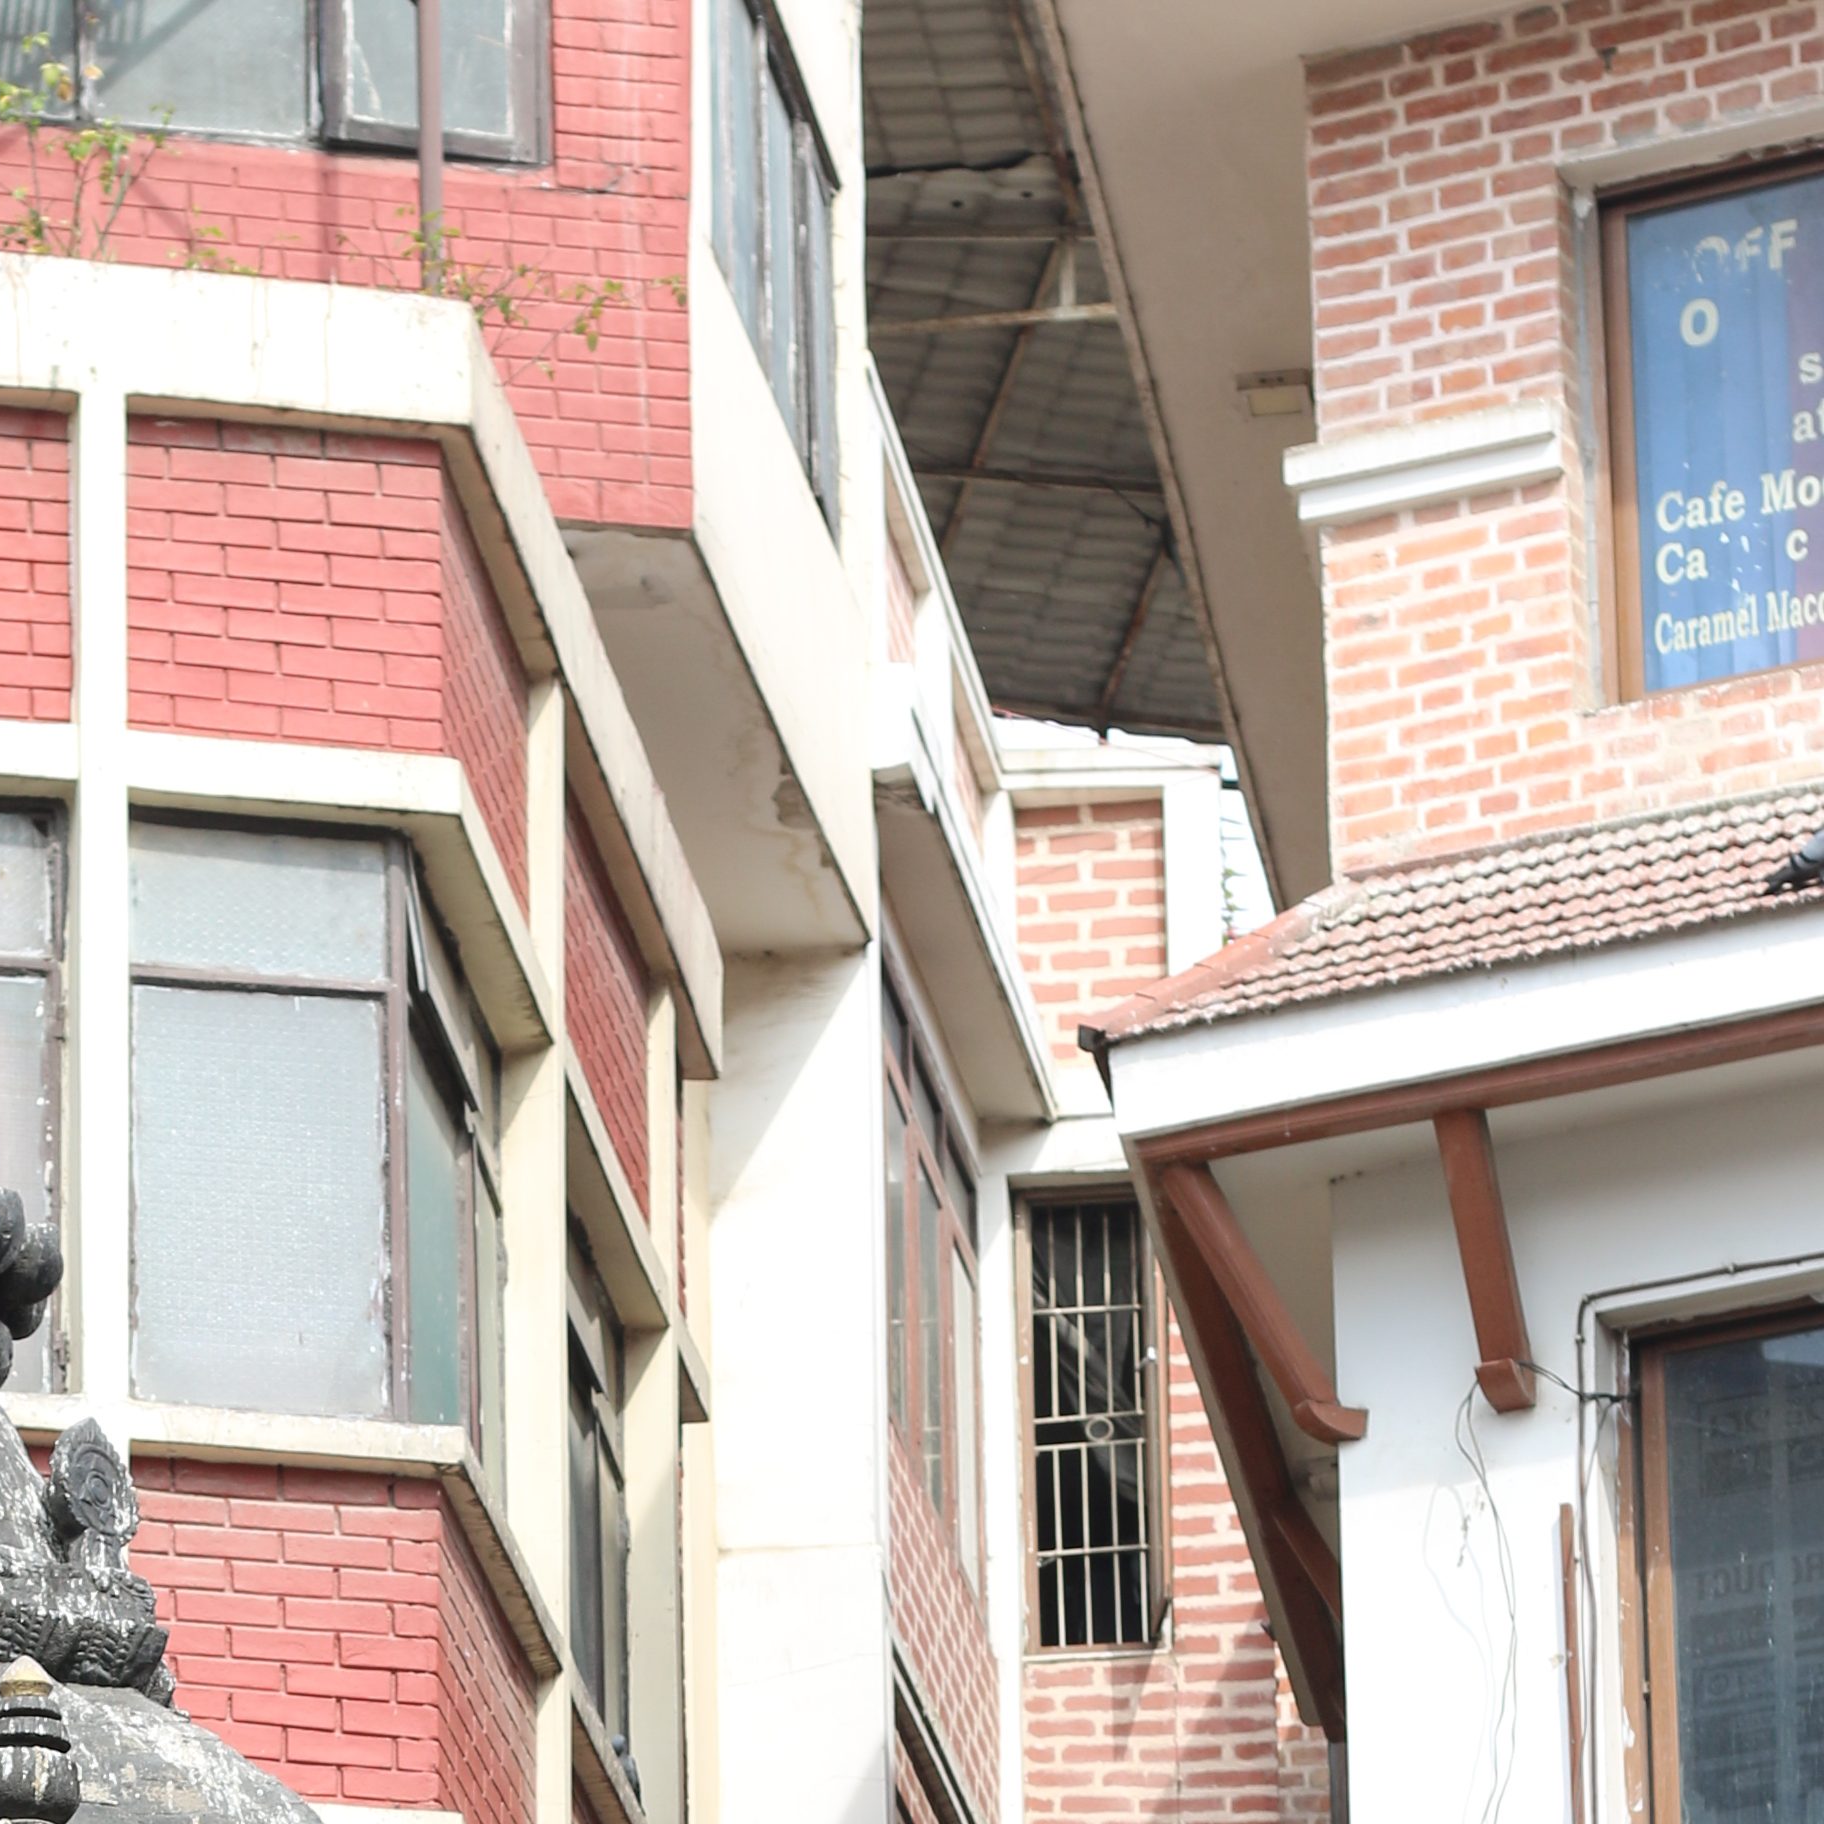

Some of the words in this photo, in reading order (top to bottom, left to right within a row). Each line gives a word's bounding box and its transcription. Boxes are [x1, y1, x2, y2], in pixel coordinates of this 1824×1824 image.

[1656, 479, 1745, 532] Cafe
[1760, 469, 1824, 515] Mo
[1655, 594, 1760, 654] Caramel
